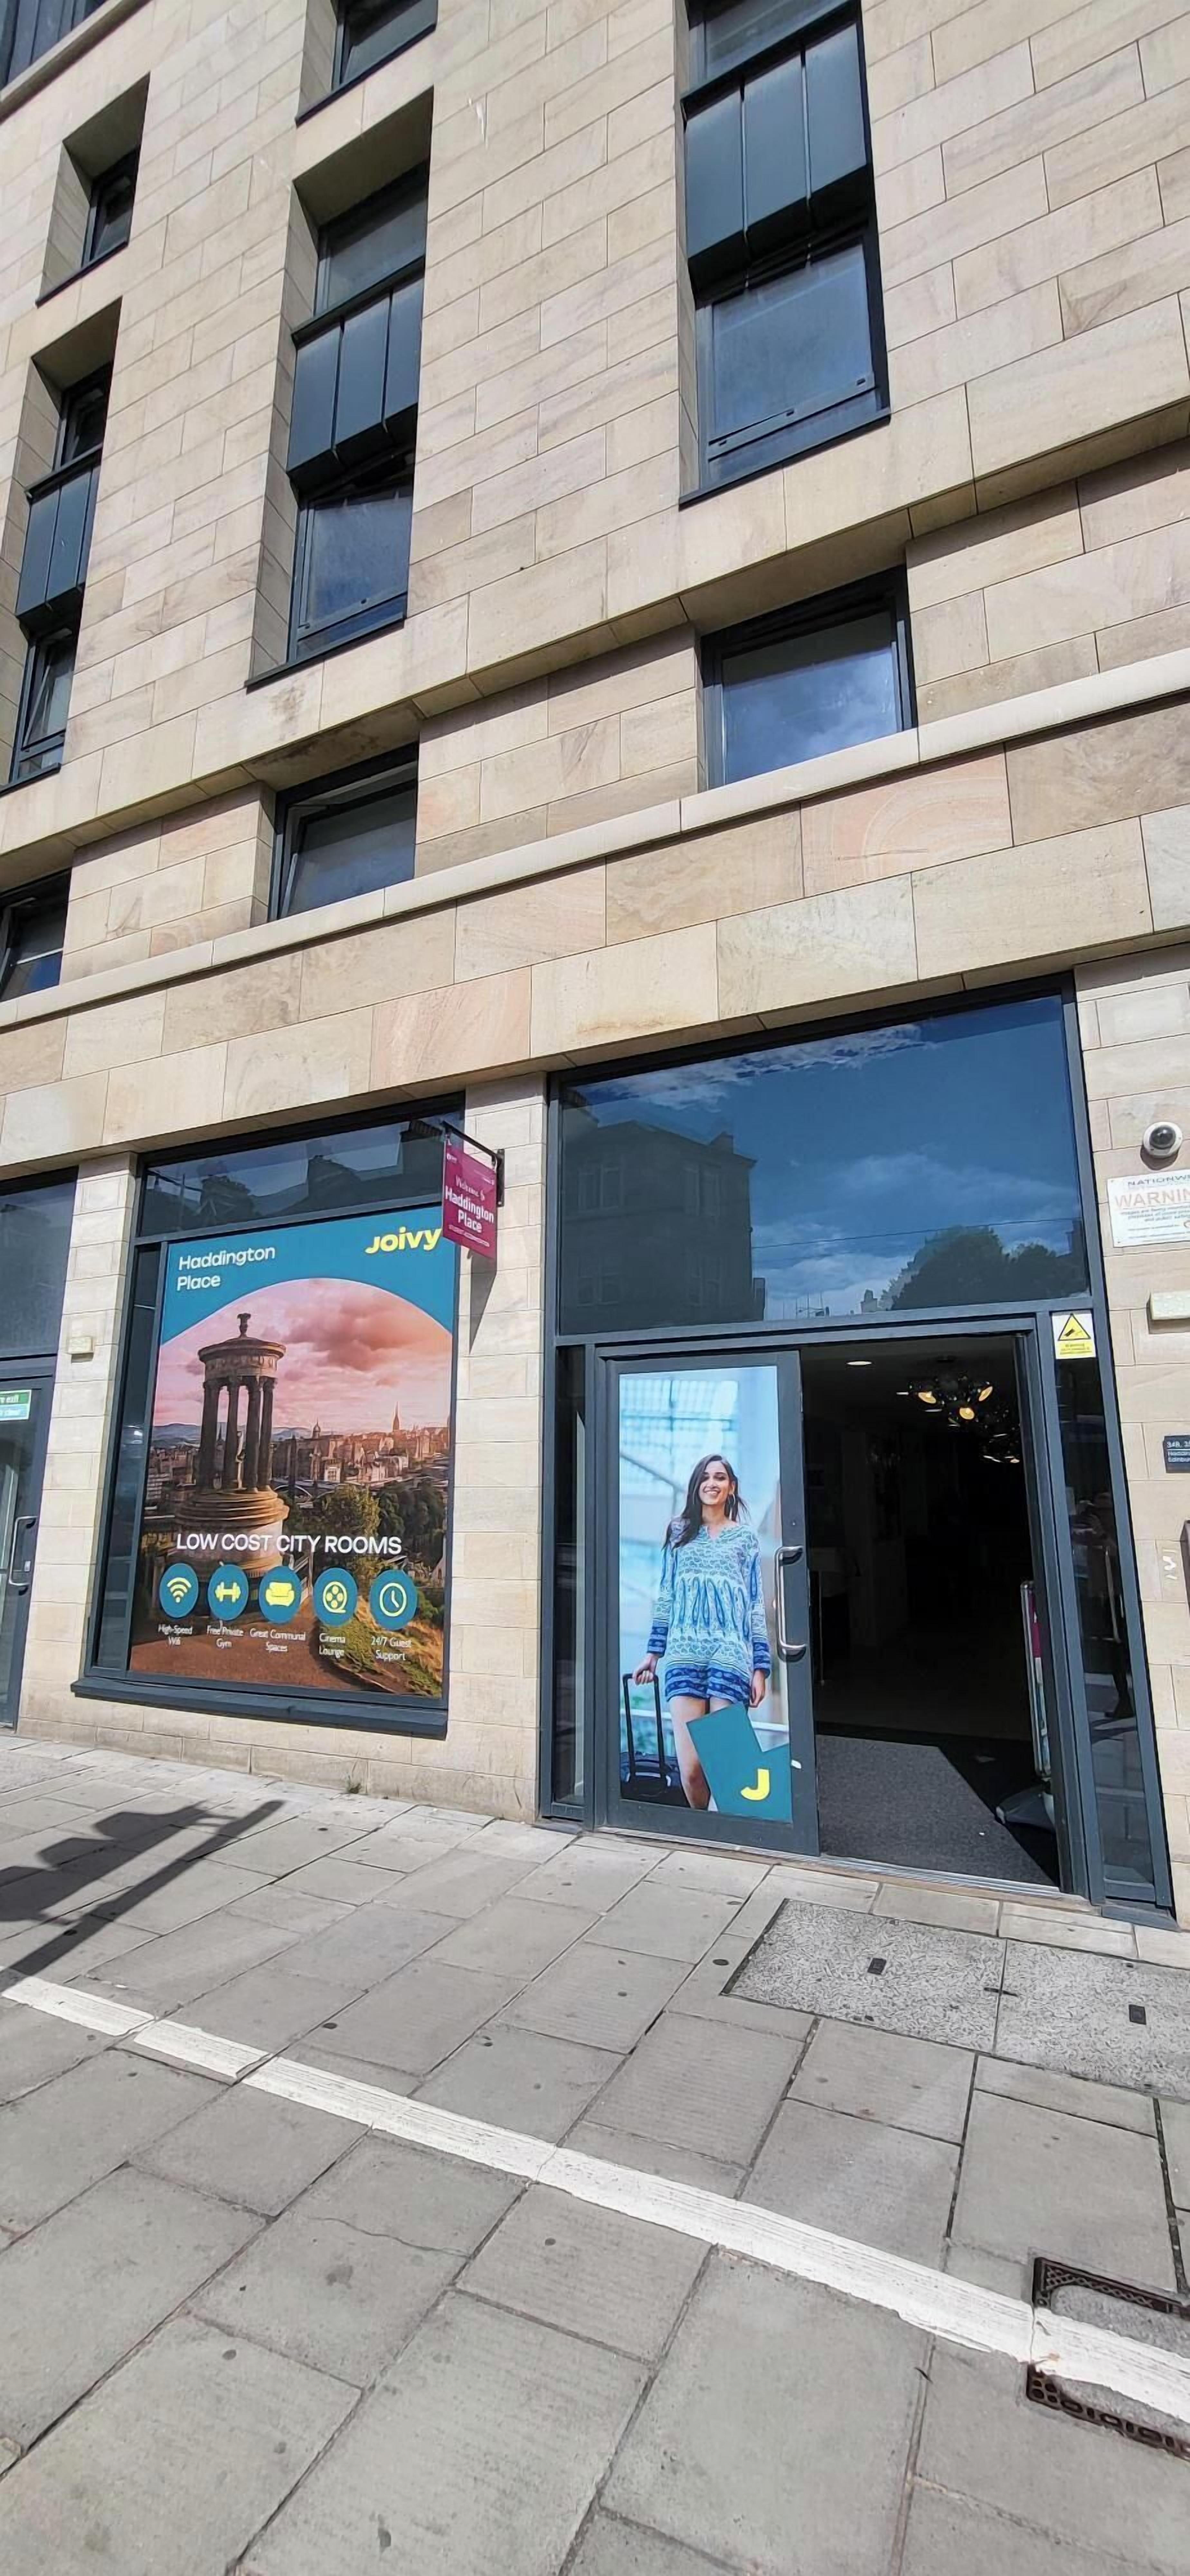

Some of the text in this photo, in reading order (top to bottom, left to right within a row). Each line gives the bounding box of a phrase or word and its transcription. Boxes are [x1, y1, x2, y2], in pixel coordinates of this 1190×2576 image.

[446, 1185, 494, 1223] Haddington
[458, 1209, 482, 1233] Place
[365, 1226, 442, 1254] Joivy
[179, 1247, 275, 1271] Haddington
[177, 1275, 221, 1291] Place
[177, 1534, 402, 1555] LOW COST CITY ROOMS
[158, 1624, 193, 1635] High-Speed
[207, 1625, 244, 1636] Free Private
[250, 1628, 306, 1641] Great Communal
[216, 1638, 232, 1649] Gym
[319, 1633, 345, 1643] Cinema
[371, 1635, 412, 1648] 24/7 Guest
[266, 1642, 287, 1653] Spaces
[319, 1645, 345, 1658] Lounge
[375, 1650, 406, 1662] Support
